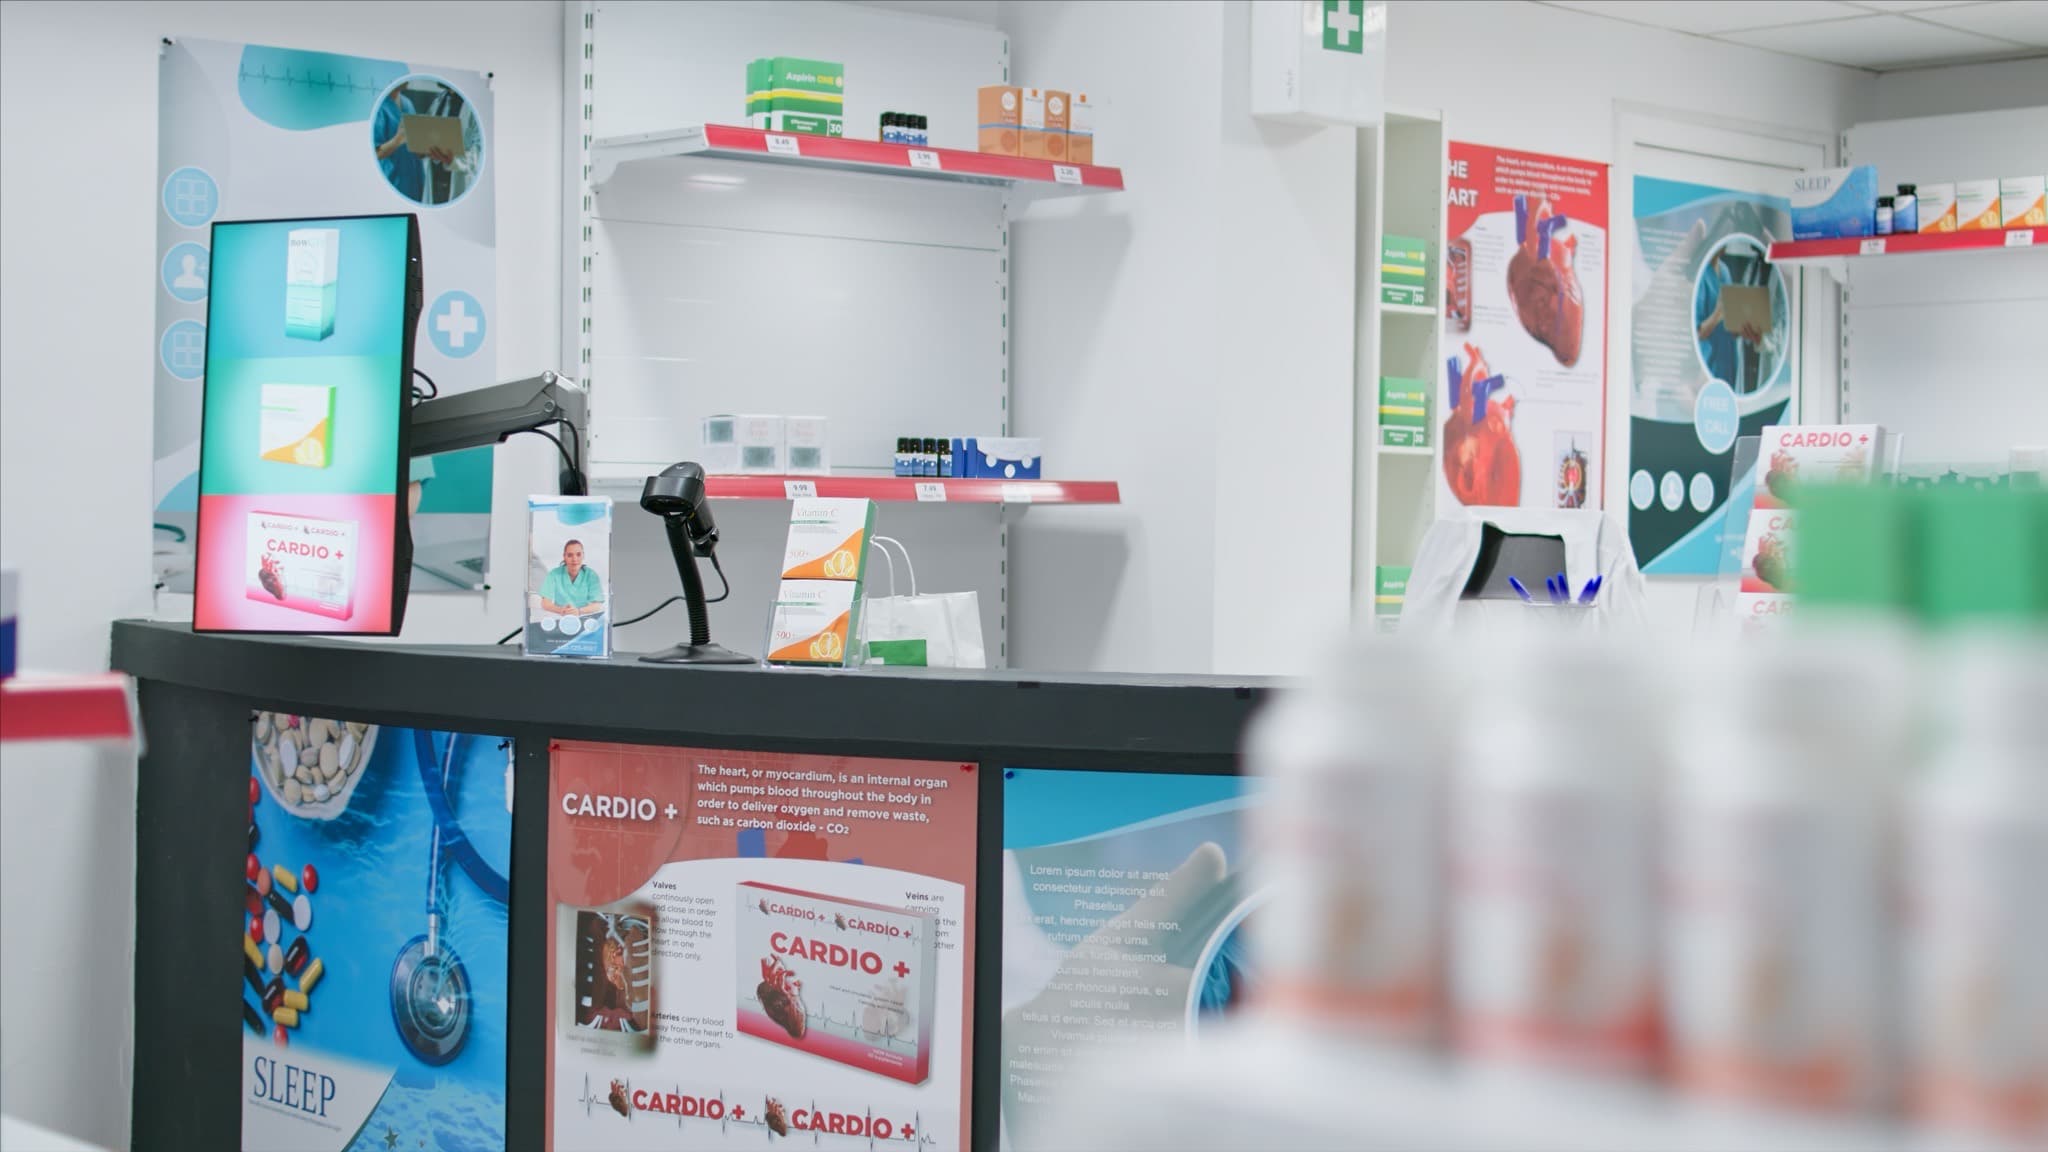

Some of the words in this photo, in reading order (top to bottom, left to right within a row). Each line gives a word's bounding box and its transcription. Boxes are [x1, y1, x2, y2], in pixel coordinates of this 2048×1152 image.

[830, 123, 842, 134] 30
[1794, 175, 1831, 192] SLEEP
[1703, 396, 1729, 412] FREE
[1705, 420, 1729, 433] CALL
[1779, 431, 1853, 448] CARDIO
[311, 527, 338, 537] CARDIO
[266, 538, 329, 559] CARDIO
[697, 764, 717, 775] The
[719, 765, 750, 779] heart,
[751, 768, 763, 778] or
[765, 769, 836, 784] myocardium,
[838, 772, 848, 783] is
[850, 775, 864, 784] an
[867, 773, 911, 786] internal
[913, 777, 948, 789] organ
[697, 781, 727, 793] which
[729, 784, 765, 796] pumps
[767, 785, 799, 797] blood
[801, 787, 864, 801] throughout
[866, 791, 885, 802] the
[888, 792, 917, 806] body
[920, 793, 932, 804] in
[562, 792, 657, 822] CARDIO
[697, 797, 725, 809] order
[727, 799, 739, 810] to
[741, 800, 778, 813] deliver
[780, 805, 820, 816] oxygen
[823, 806, 844, 817] and
[847, 808, 889, 820] remove
[892, 811, 930, 824] waste,
[697, 815, 720, 825] such
[722, 817, 734, 826] as
[736, 817, 773, 829] carbon
[775, 820, 816, 832] dioxide
[1030, 864, 1063, 876] Lorem
[1064, 866, 1096, 878] ipsum
[1098, 867, 1124, 879] dolor
[1127, 869, 1139, 880] sit
[652, 880, 677, 890] Valves
[1032, 881, 1092, 894] consectetur
[1094, 883, 1147, 898] adipiscing
[652, 892, 694, 905] continously
[695, 896, 715, 905] open
[905, 891, 929, 901] Veins
[667, 905, 687, 914] close
[688, 906, 695, 914] in
[696, 908, 718, 917] order
[770, 903, 816, 920] CARDIO
[1074, 899, 1125, 911] Phasellus
[681, 917, 704, 927] blood
[704, 919, 714, 927] to
[847, 918, 900, 937] CARDIO
[942, 918, 957, 926] the
[668, 927, 698, 938] through
[699, 929, 712, 939] the
[680, 940, 695, 949] one
[769, 931, 883, 975] CARDIO
[1155, 986, 1169, 996] eu
[681, 1015, 700, 1025] carry
[702, 1016, 724, 1027] blood
[659, 1033, 672, 1042] the
[673, 1035, 694, 1046] other
[670, 1024, 688, 1033] from
[689, 1027, 702, 1035] the
[703, 1028, 723, 1038] heart
[725, 1031, 734, 1039] to
[253, 1055, 336, 1118] SLEEP
[632, 1088, 725, 1120] CARDIO
[791, 1108, 893, 1140] CARDIO
